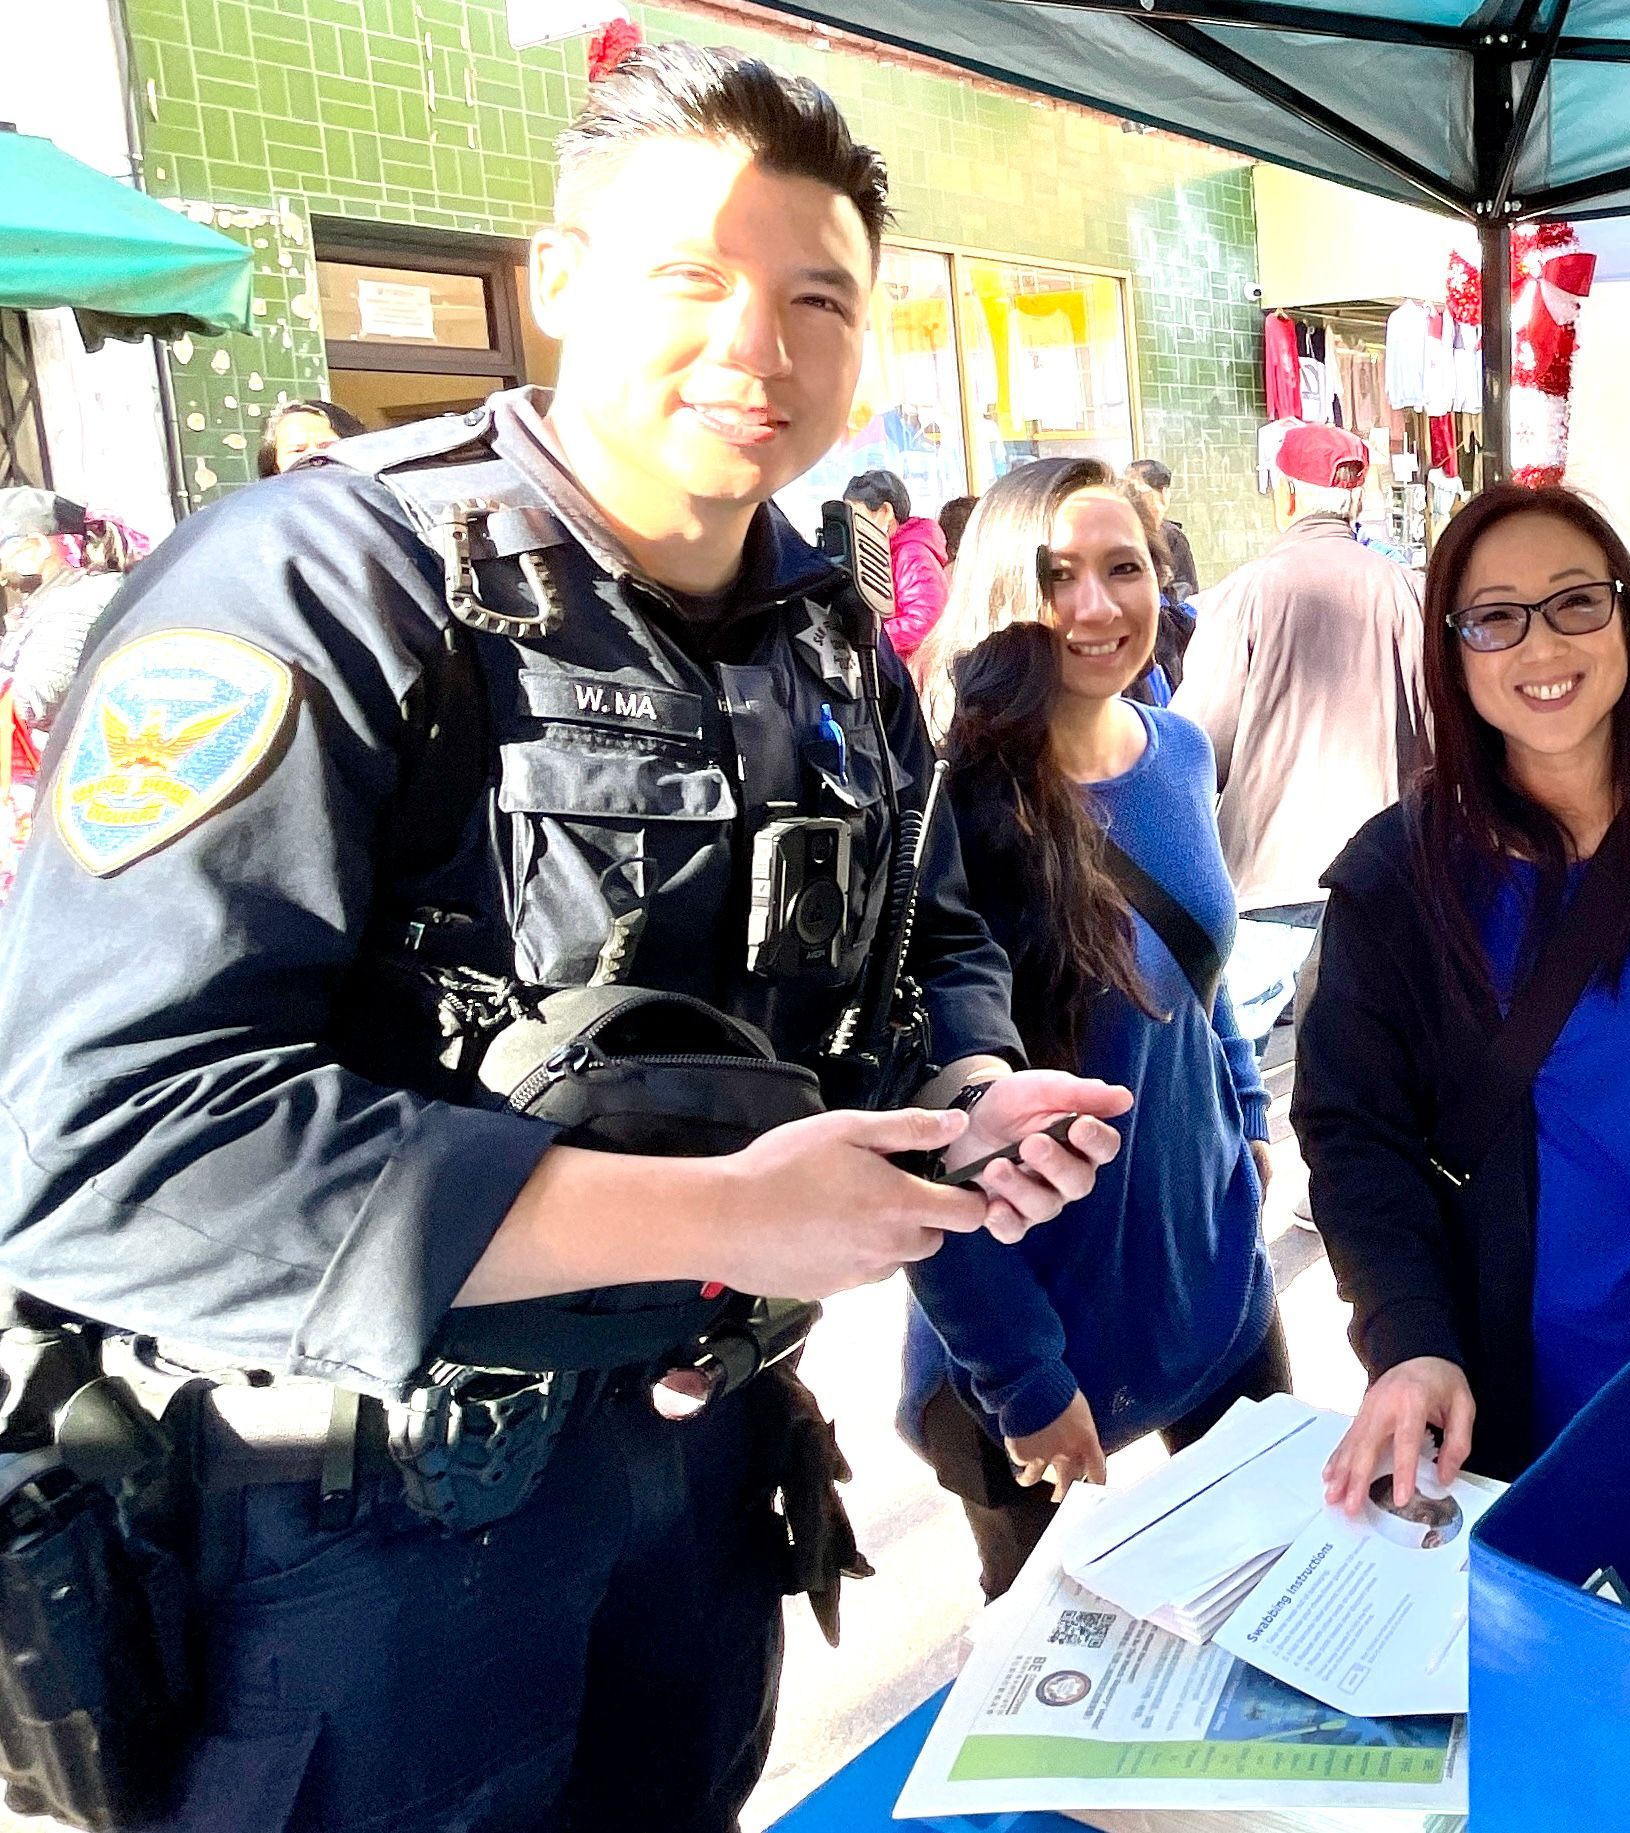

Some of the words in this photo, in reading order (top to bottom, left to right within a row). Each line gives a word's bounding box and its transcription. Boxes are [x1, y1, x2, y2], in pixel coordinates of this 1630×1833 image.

[574, 683, 611, 714] W.
[614, 690, 657, 721] MA
[1246, 1594, 1292, 1643] Swabbing
[1287, 1542, 1334, 1596] Instructions
